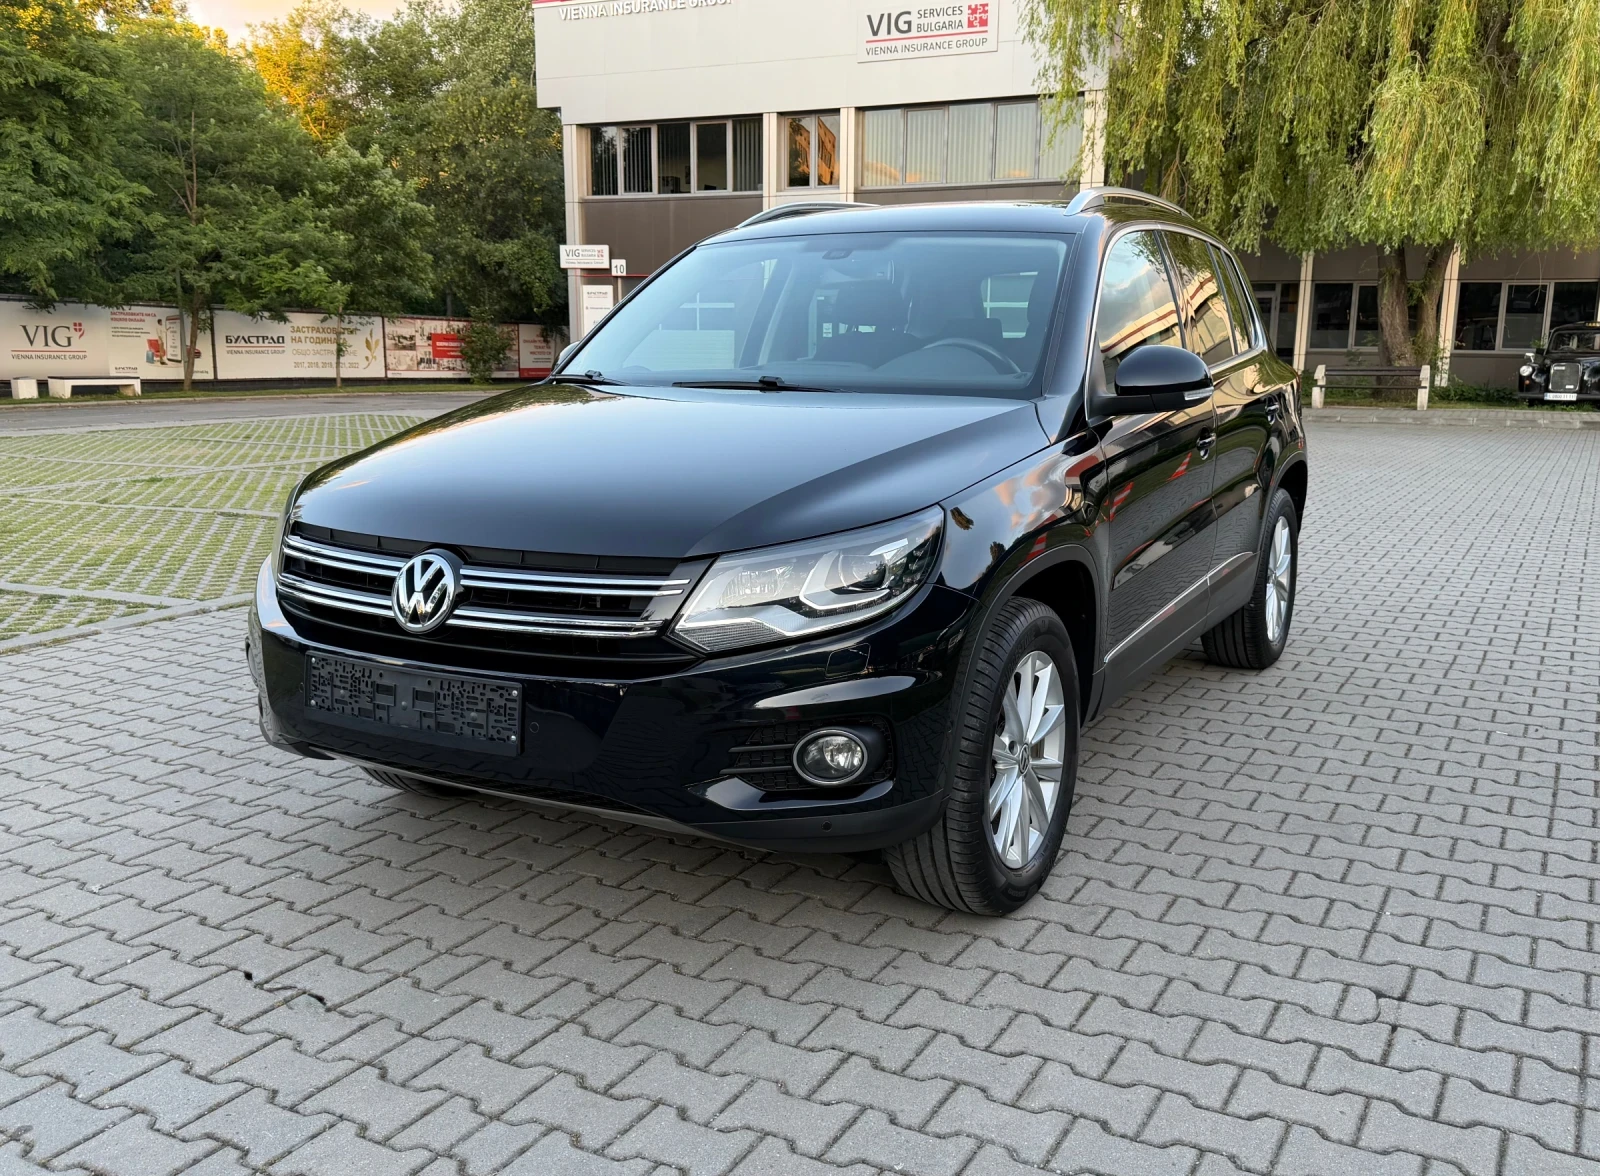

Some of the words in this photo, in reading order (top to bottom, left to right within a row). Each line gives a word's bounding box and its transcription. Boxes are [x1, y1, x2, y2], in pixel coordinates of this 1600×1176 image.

[559, 6, 608, 20] VIENNA
[611, 0, 686, 16] INSURANCE
[917, 5, 963, 19] SERVICES
[866, 11, 912, 37] VIG
[916, 19, 964, 33] BULGARIA
[865, 45, 899, 56] VIENNA
[900, 40, 953, 53] INSURANCE
[955, 37, 988, 49] GROUP
[565, 249, 580, 257] VIG
[614, 264, 625, 274] 10
[19, 324, 73, 348] VIG
[225, 335, 285, 344] БУЛСТРАД
[290, 336, 303, 344] НА
[292, 348, 311, 356] ОБЩО
